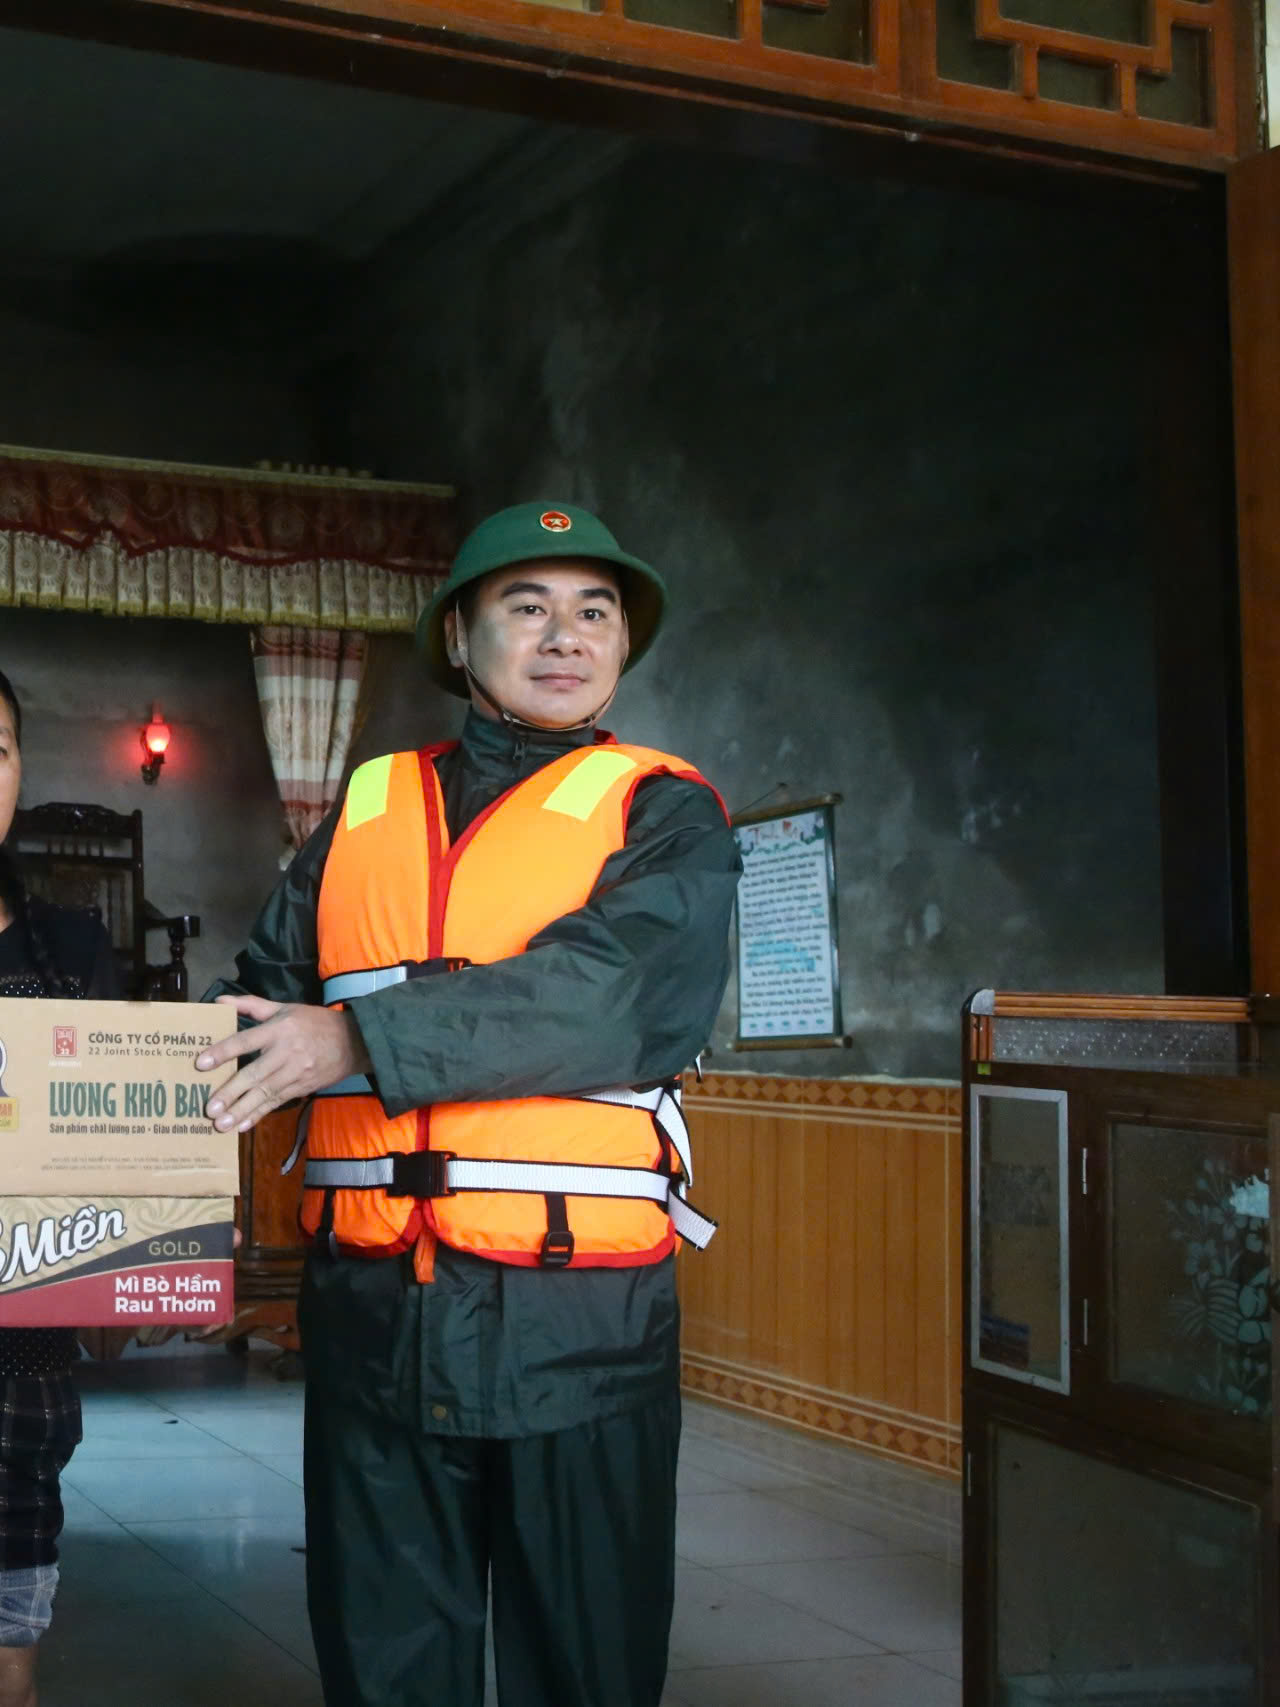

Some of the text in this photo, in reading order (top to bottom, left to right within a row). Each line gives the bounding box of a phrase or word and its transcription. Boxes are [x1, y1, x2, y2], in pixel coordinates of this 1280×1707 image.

[88, 1031, 122, 1044] CÔNG
[127, 1034, 141, 1044] TY
[198, 1036, 212, 1046] 22
[88, 1046, 100, 1055] 22
[104, 1047, 130, 1056] Joint
[134, 1047, 162, 1056] Stock
[124, 1080, 167, 1118] KHÔ
[175, 1083, 212, 1118] BAY
[131, 1125, 146, 1134] cao
[148, 1241, 201, 1256] GOLD
[115, 1273, 221, 1293] Mì Bò Hầm
[115, 1295, 216, 1313] Rau Thơm
